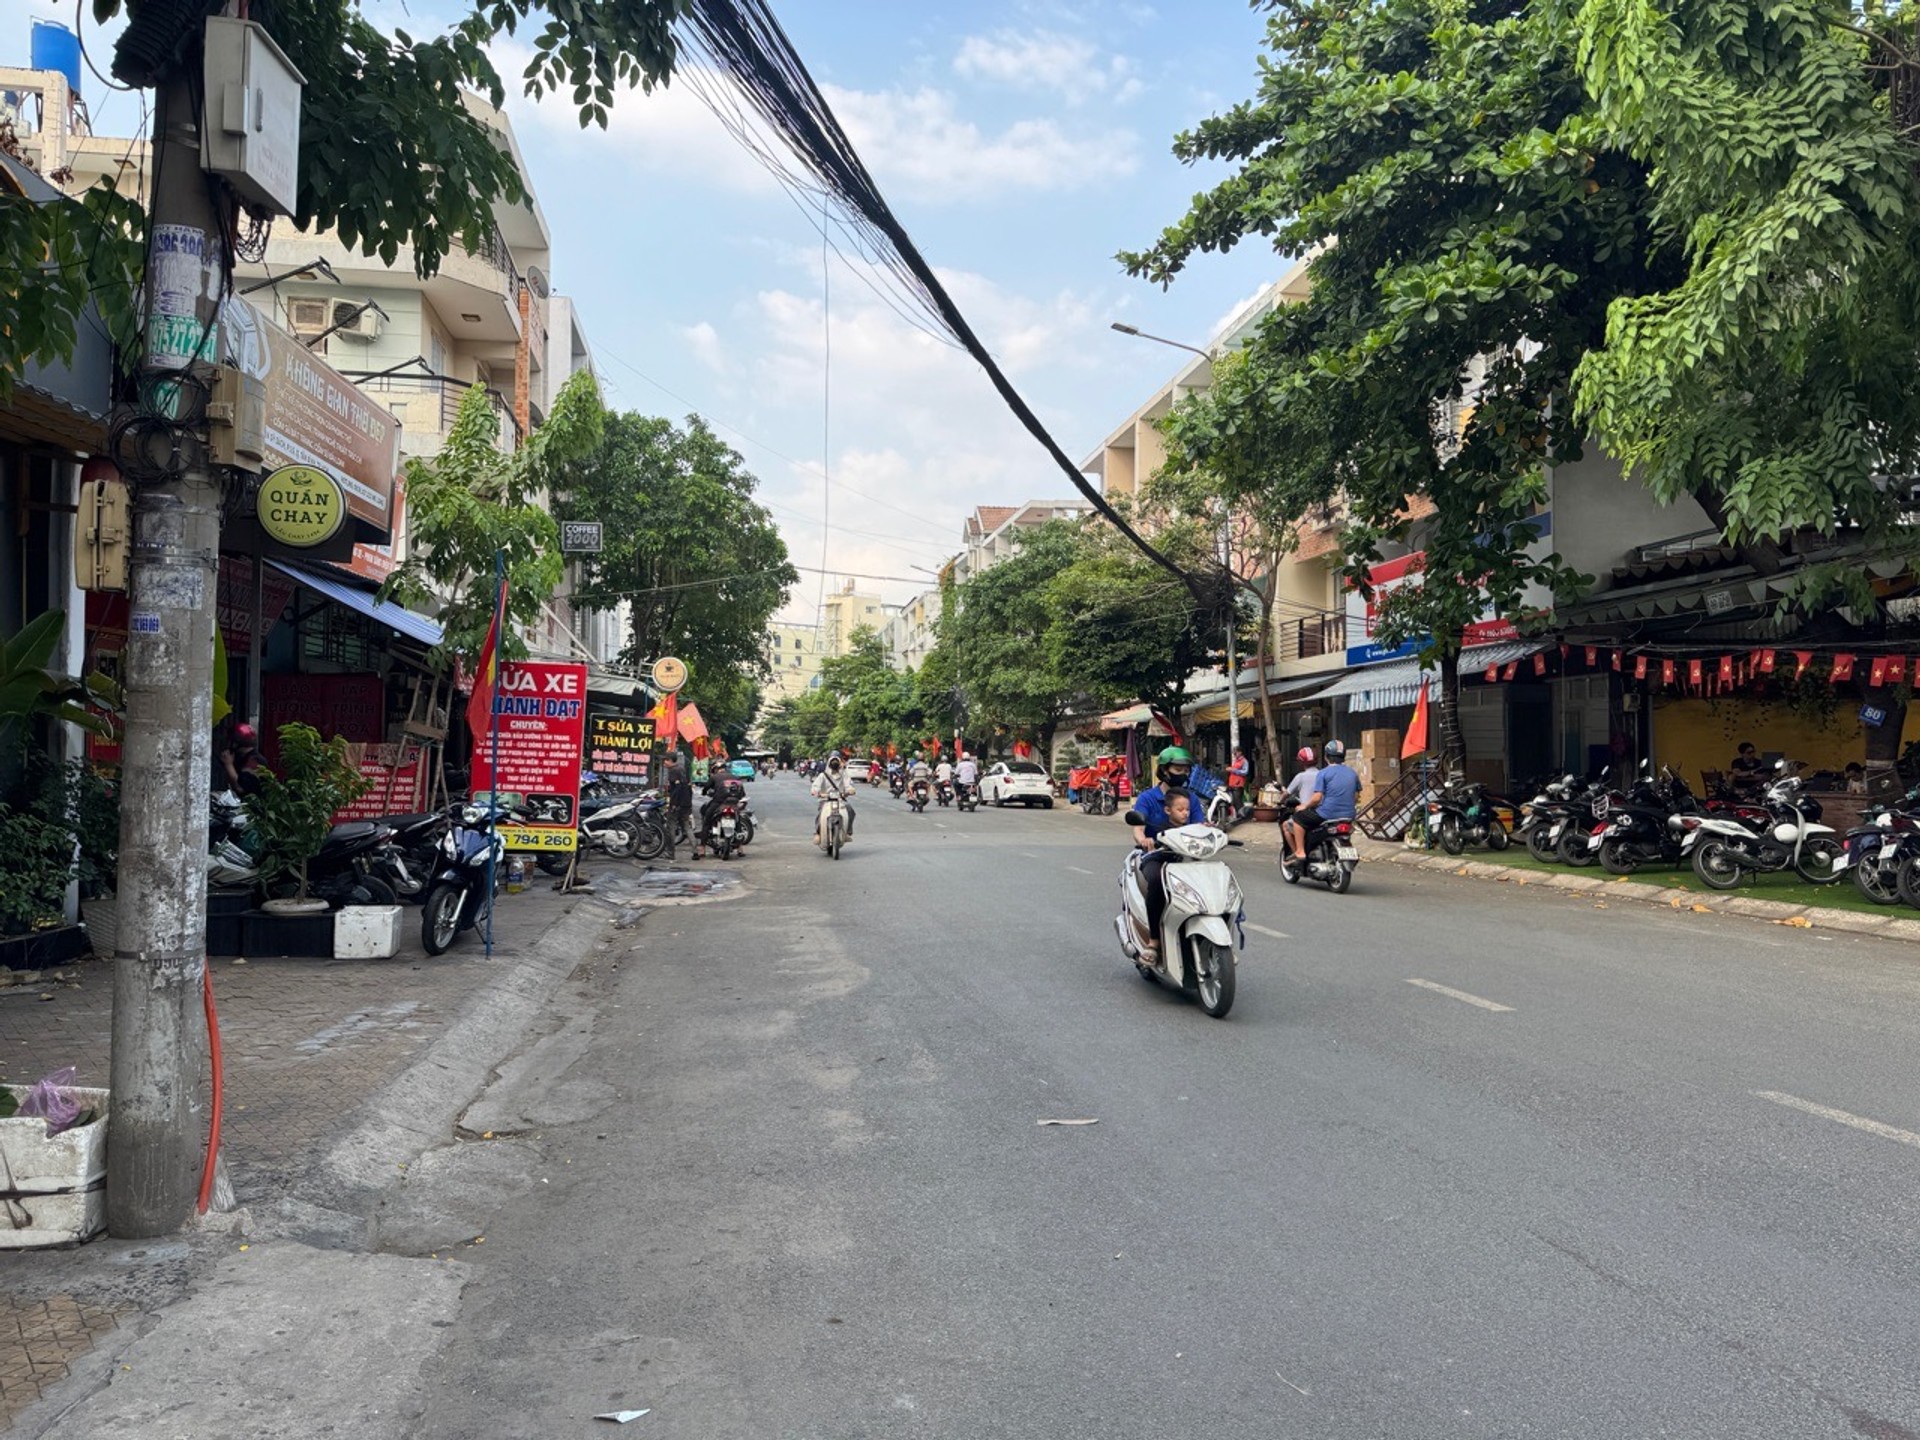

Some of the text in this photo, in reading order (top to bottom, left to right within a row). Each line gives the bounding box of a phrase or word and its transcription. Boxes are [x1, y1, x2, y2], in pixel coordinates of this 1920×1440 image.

[286, 352, 324, 402] KHÔNG
[326, 384, 349, 420] GIAN
[270, 489, 329, 506] QUÁN
[271, 509, 328, 524] CHAY
[566, 525, 598, 534] COFFEE
[544, 673, 578, 694] XE
[546, 698, 581, 721] ĐẠT
[1864, 707, 1881, 720] 80
[510, 720, 548, 730] CHUYÊN:
[608, 718, 653, 734] SỬA XE
[593, 733, 652, 752] THÀNH LỢI
[514, 834, 540, 845] 794
[544, 836, 572, 846] 260
